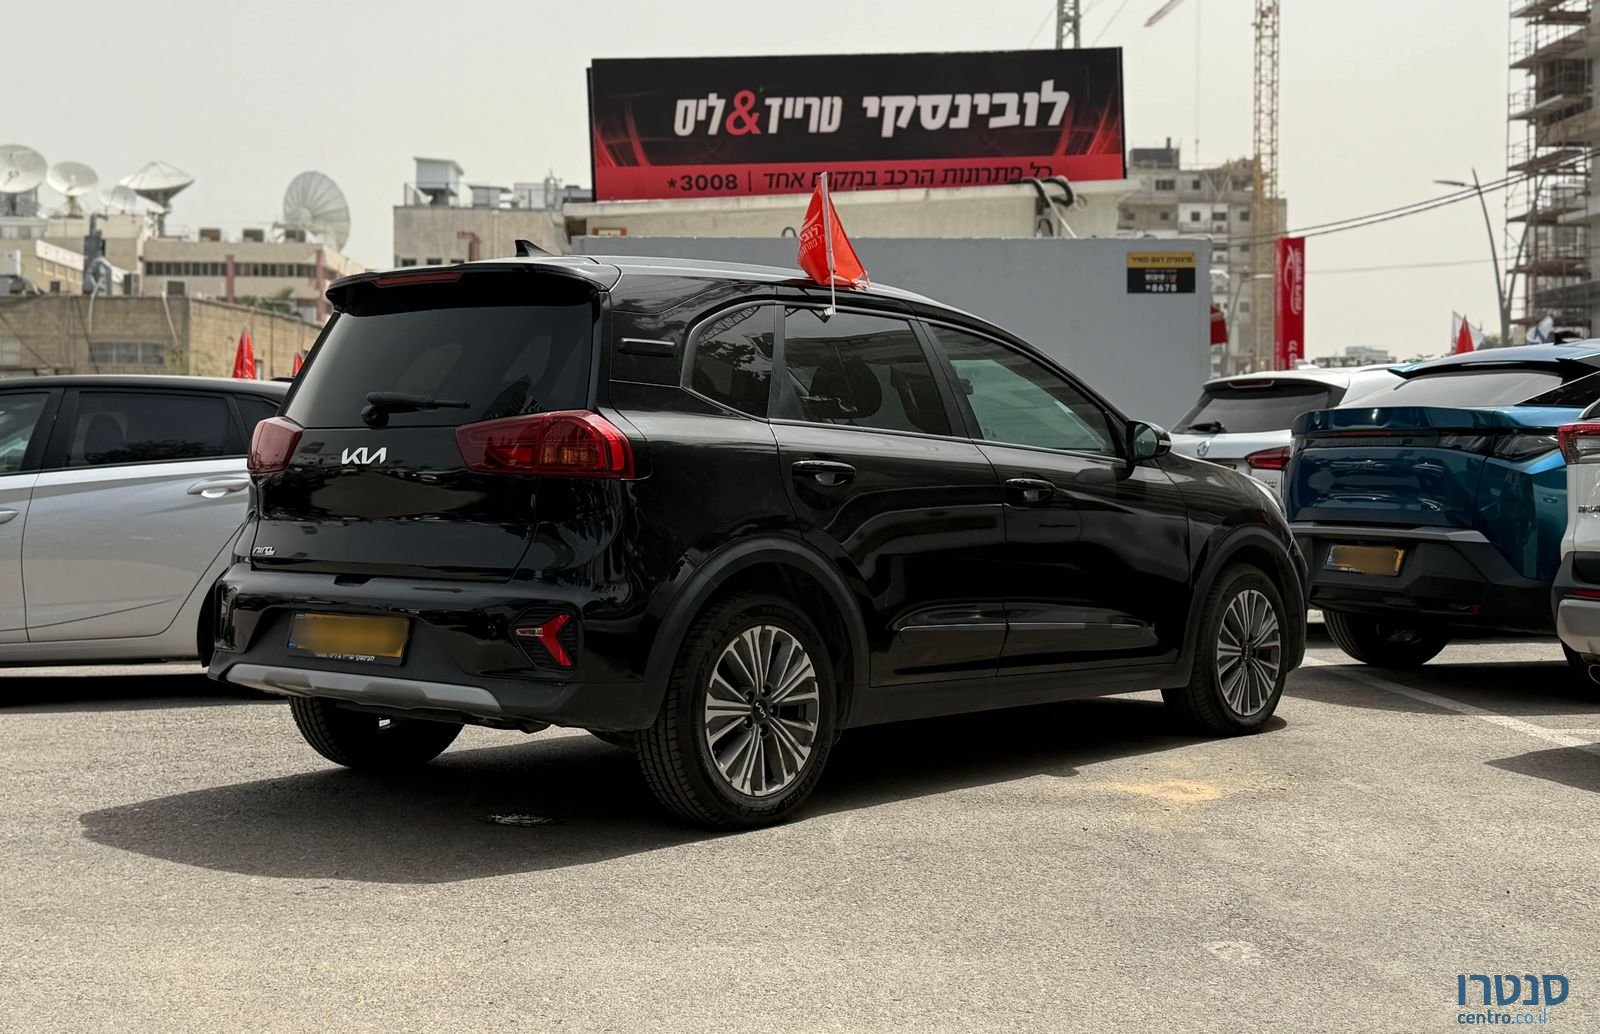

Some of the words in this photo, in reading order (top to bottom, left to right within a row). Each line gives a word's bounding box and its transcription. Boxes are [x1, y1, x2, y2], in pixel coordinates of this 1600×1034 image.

[673, 89, 843, 137] טרייד&ליס
[862, 79, 1070, 138] לובינסקי
[883, 168, 935, 187] הרכב
[940, 166, 1024, 185] פתרונות
[1029, 162, 1053, 179] כל
[763, 172, 806, 190] אחד
[811, 170, 877, 192] במקום
[341, 447, 387, 465] KIA
